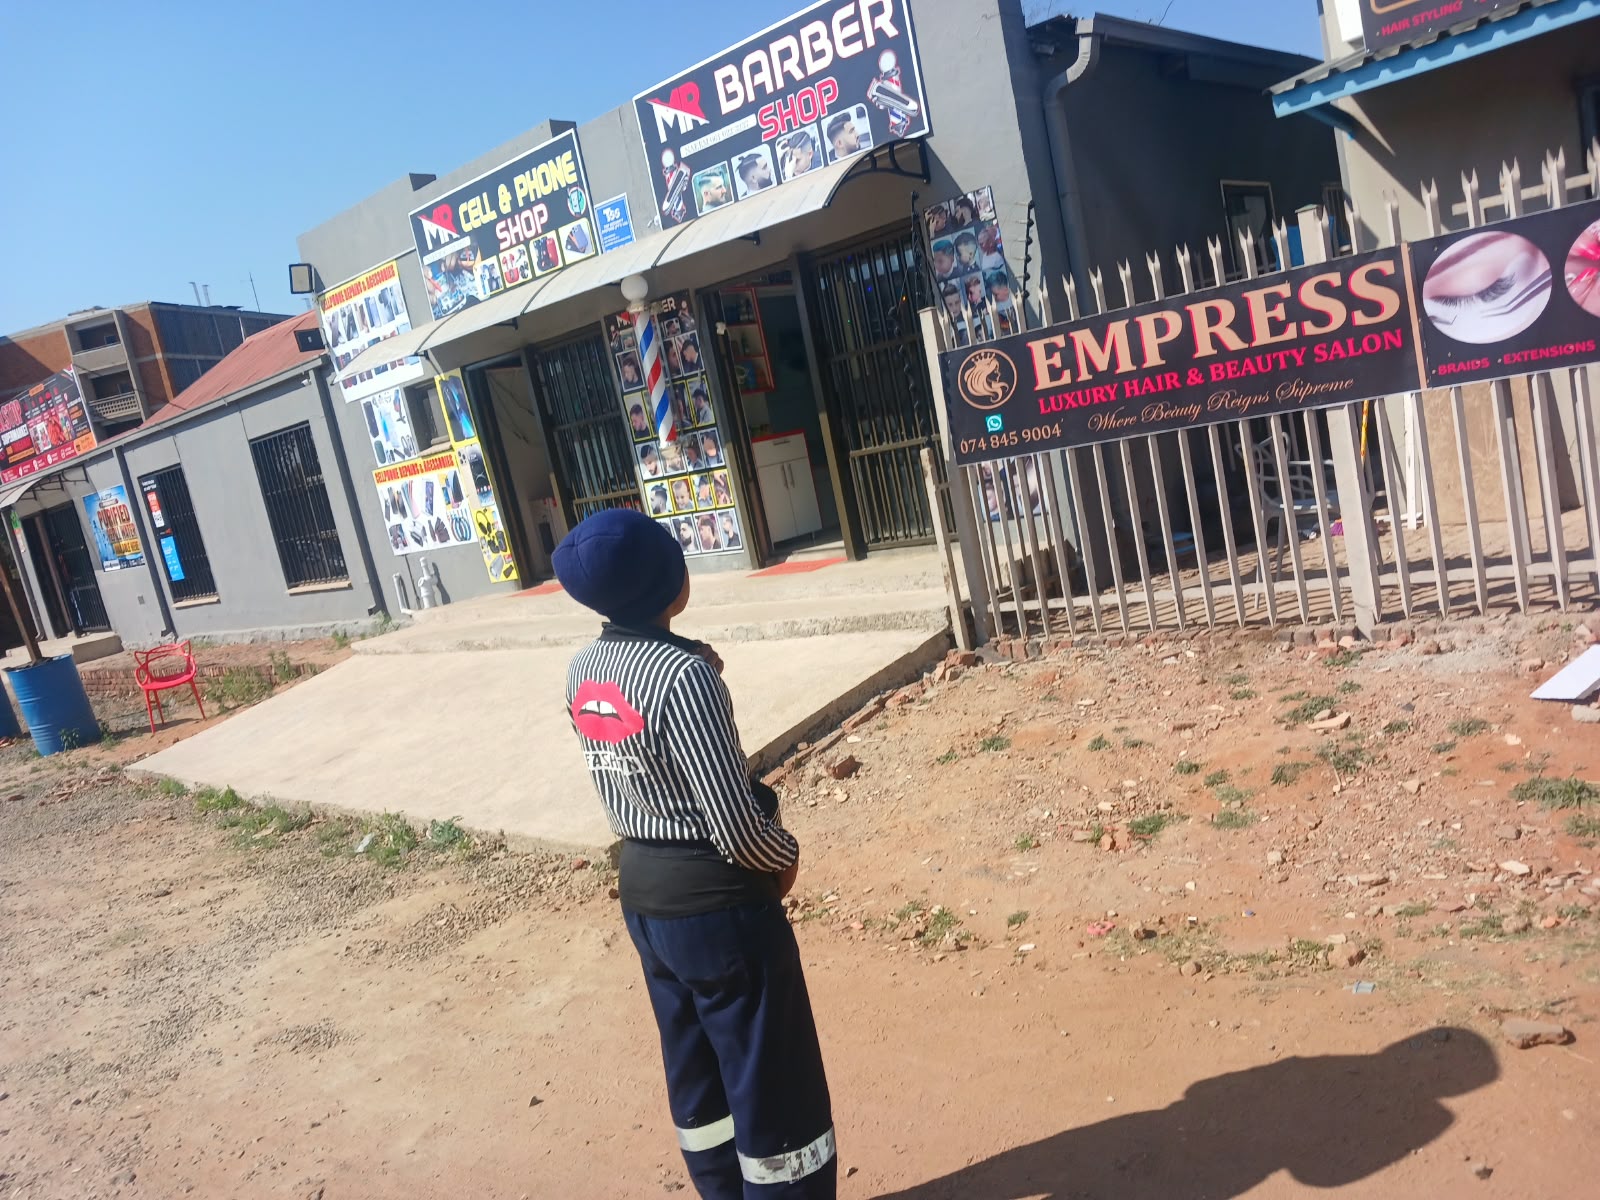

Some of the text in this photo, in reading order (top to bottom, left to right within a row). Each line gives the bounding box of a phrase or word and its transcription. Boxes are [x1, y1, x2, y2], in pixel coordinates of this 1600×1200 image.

[1381, 1, 1463, 37] HAIR STYLING
[646, 81, 709, 143] MR
[714, 0, 899, 115] BARBER
[758, 76, 838, 142] SHOP
[418, 150, 578, 250] MR CELL & PHONE
[495, 203, 549, 250] SHOP
[1026, 260, 1402, 392] EMPRESS
[1038, 328, 1403, 413] LUXURY HAIR & BEAUTY SALON
[1438, 339, 1597, 376] BRAIDS EXTENSIONS
[1087, 377, 1355, 433] Where Beauty Reigns Supreme
[960, 423, 1062, 455] 074 845 9004
[375, 467, 399, 484] CELLPHONE
[399, 463, 420, 479] REPAIRS
[97, 504, 130, 530] PURIFIED
